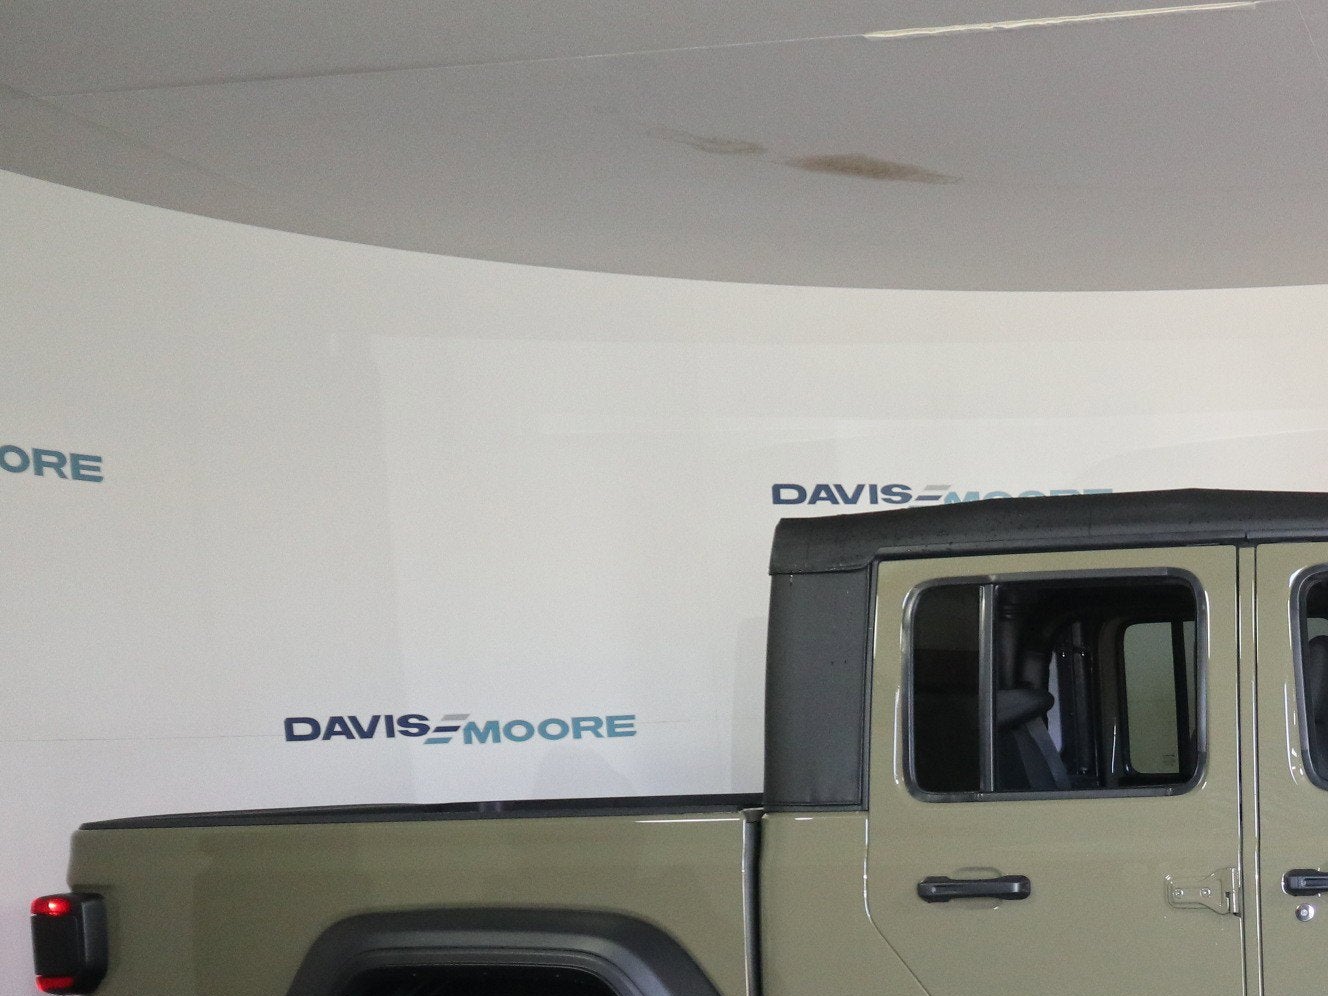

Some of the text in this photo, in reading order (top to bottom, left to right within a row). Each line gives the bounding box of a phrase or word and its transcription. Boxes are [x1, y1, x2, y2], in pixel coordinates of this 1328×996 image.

[771, 483, 913, 505] DAVIS
[284, 713, 637, 744] DAVIS MOORE
